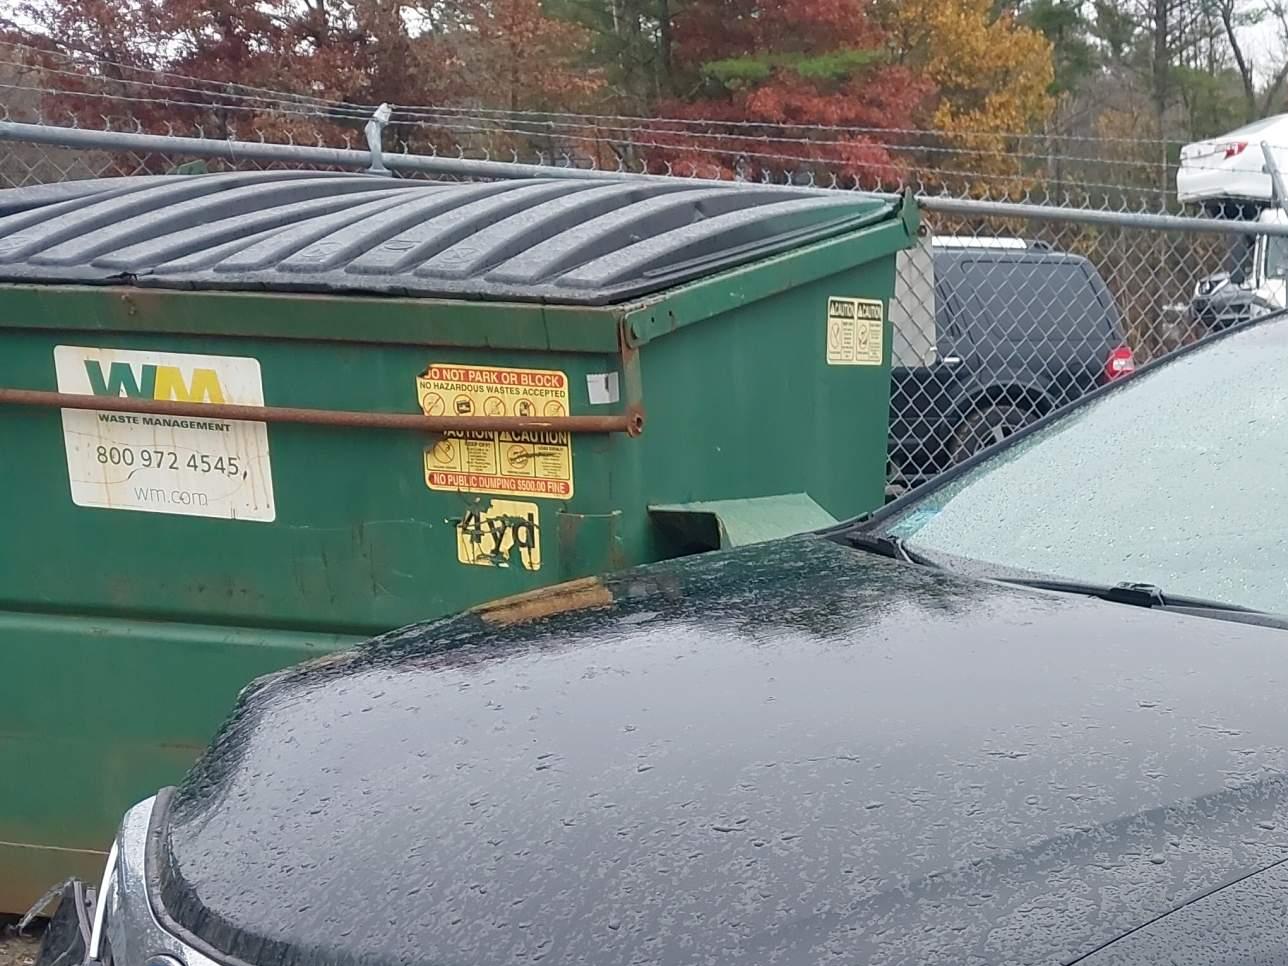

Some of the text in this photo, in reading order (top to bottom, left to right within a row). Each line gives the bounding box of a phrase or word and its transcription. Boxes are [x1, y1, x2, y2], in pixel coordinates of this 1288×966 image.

[84, 359, 226, 404] WM
[442, 369, 467, 381] NOT
[468, 371, 499, 384] PARK
[501, 373, 519, 385] OR
[520, 374, 561, 388] BLOCK
[419, 381, 566, 399] NO HAZARDOUS WASTES ACCEPTED
[98, 413, 232, 433] WASTE MANAGEMENT
[96, 445, 240, 477] 800 972 4545
[433, 473, 566, 494] NO PUBLIC DUMPING $500.00 FINE
[134, 486, 208, 506] wm.com
